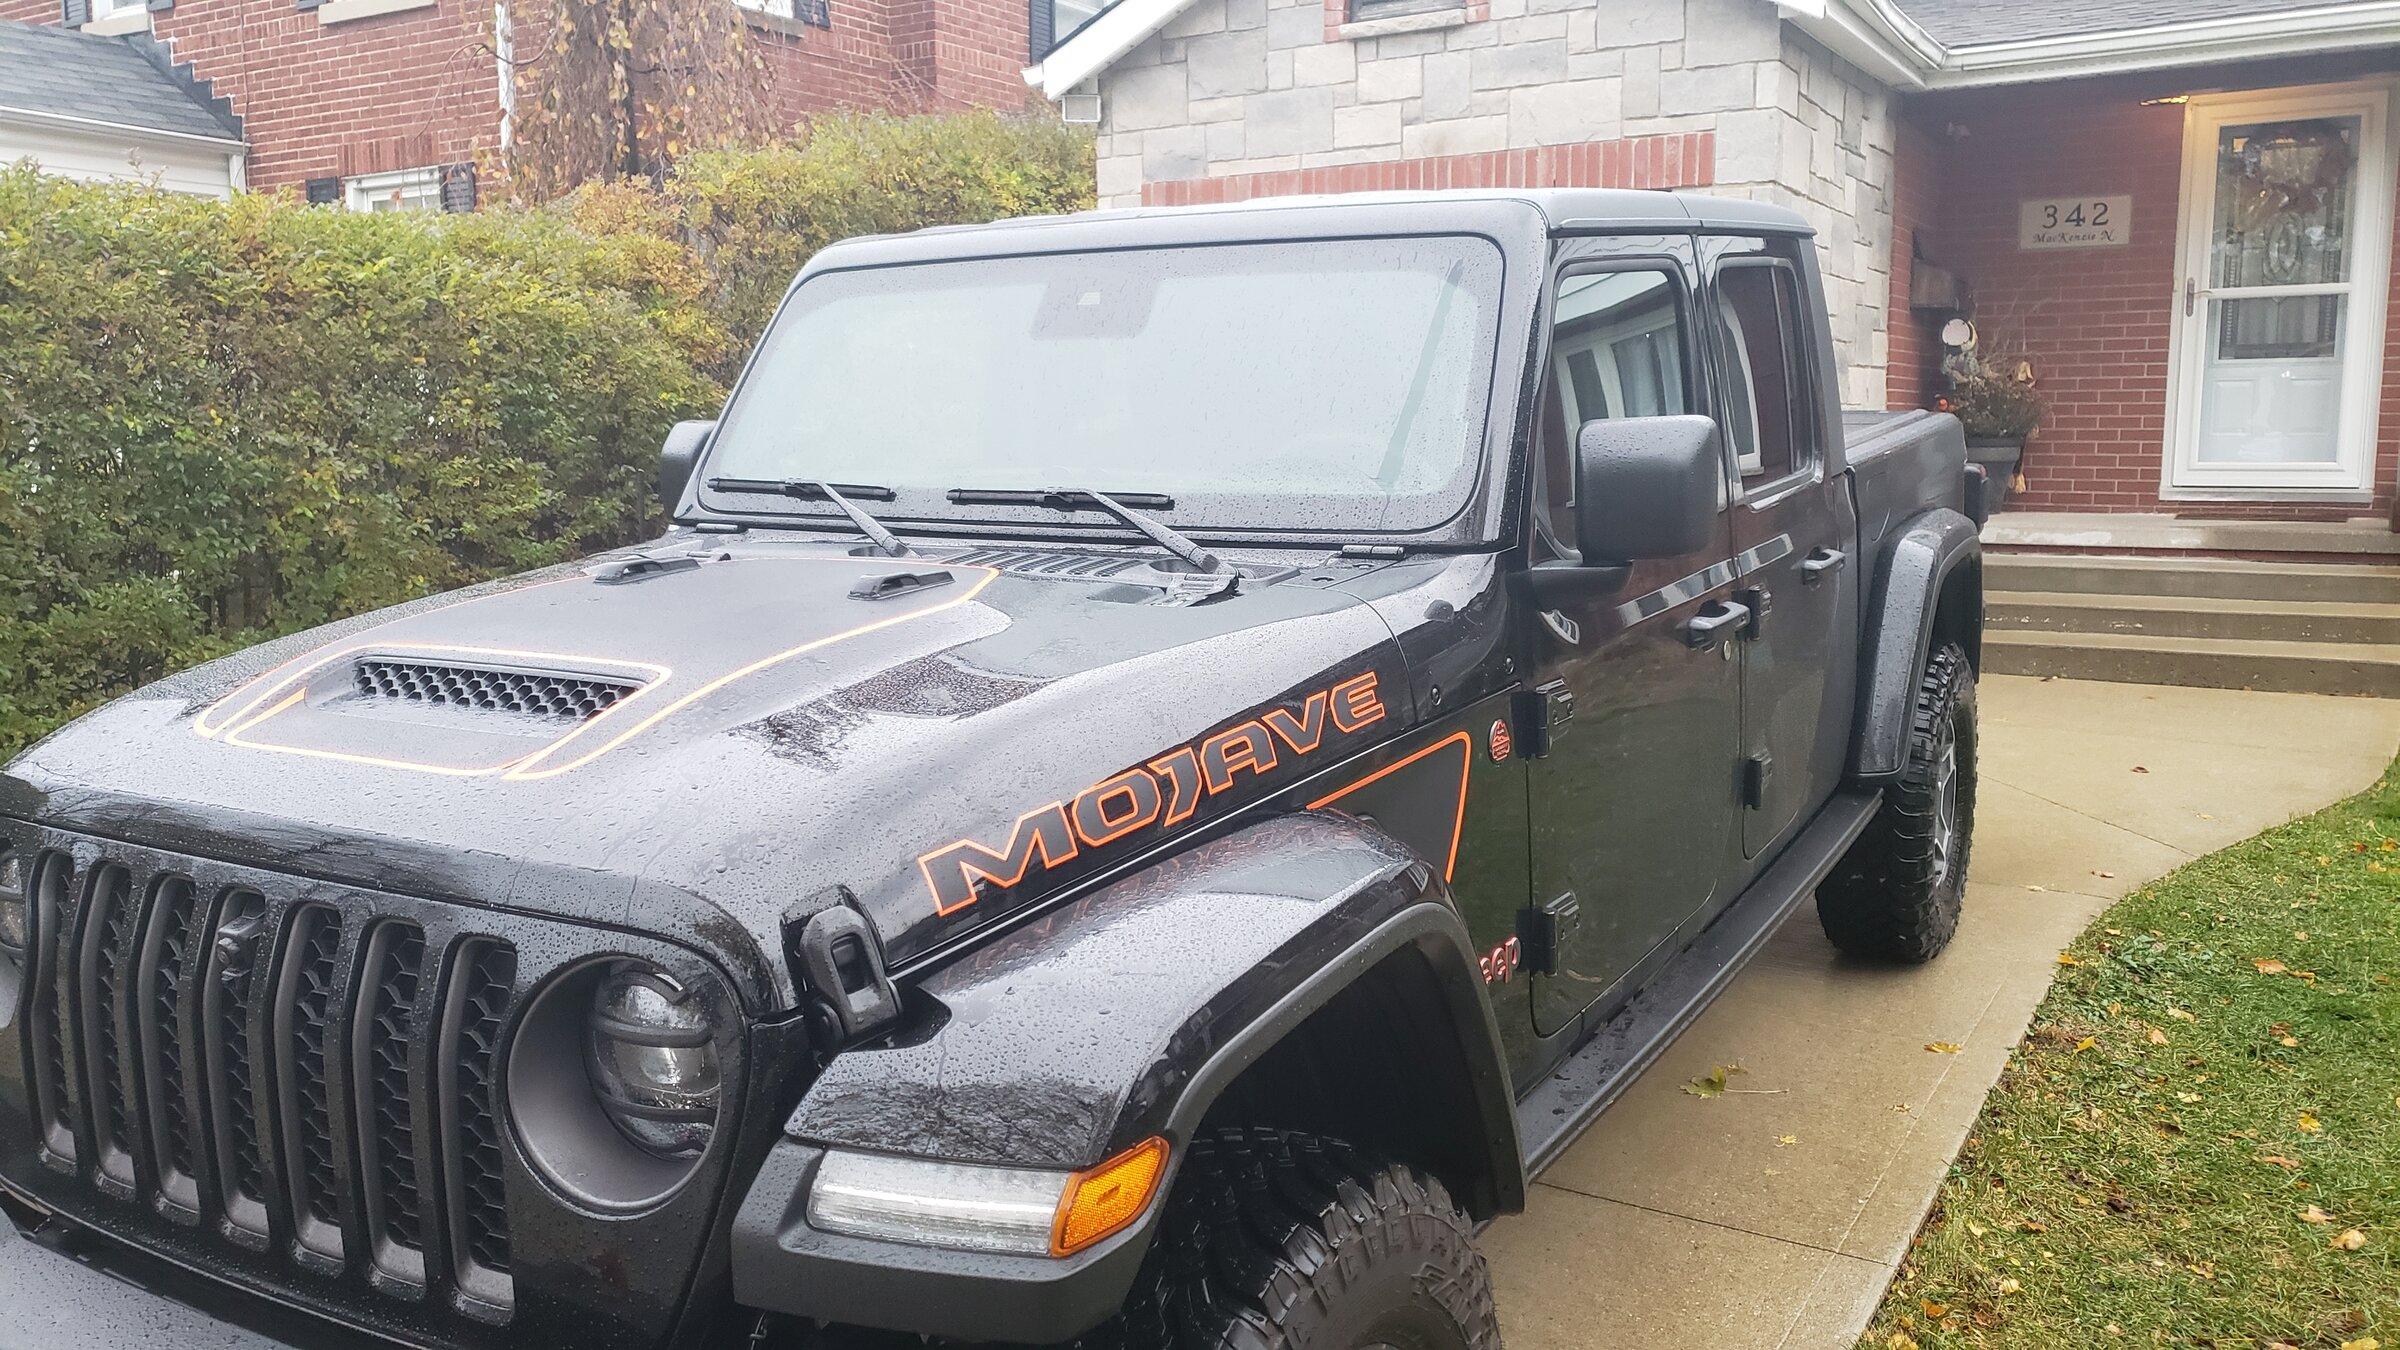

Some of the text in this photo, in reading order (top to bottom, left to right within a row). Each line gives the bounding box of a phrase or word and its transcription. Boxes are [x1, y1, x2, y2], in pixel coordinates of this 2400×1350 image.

[2042, 203, 2109, 229] 342
[918, 671, 1385, 917] MOJAVE
[1479, 936, 1521, 985] eep
